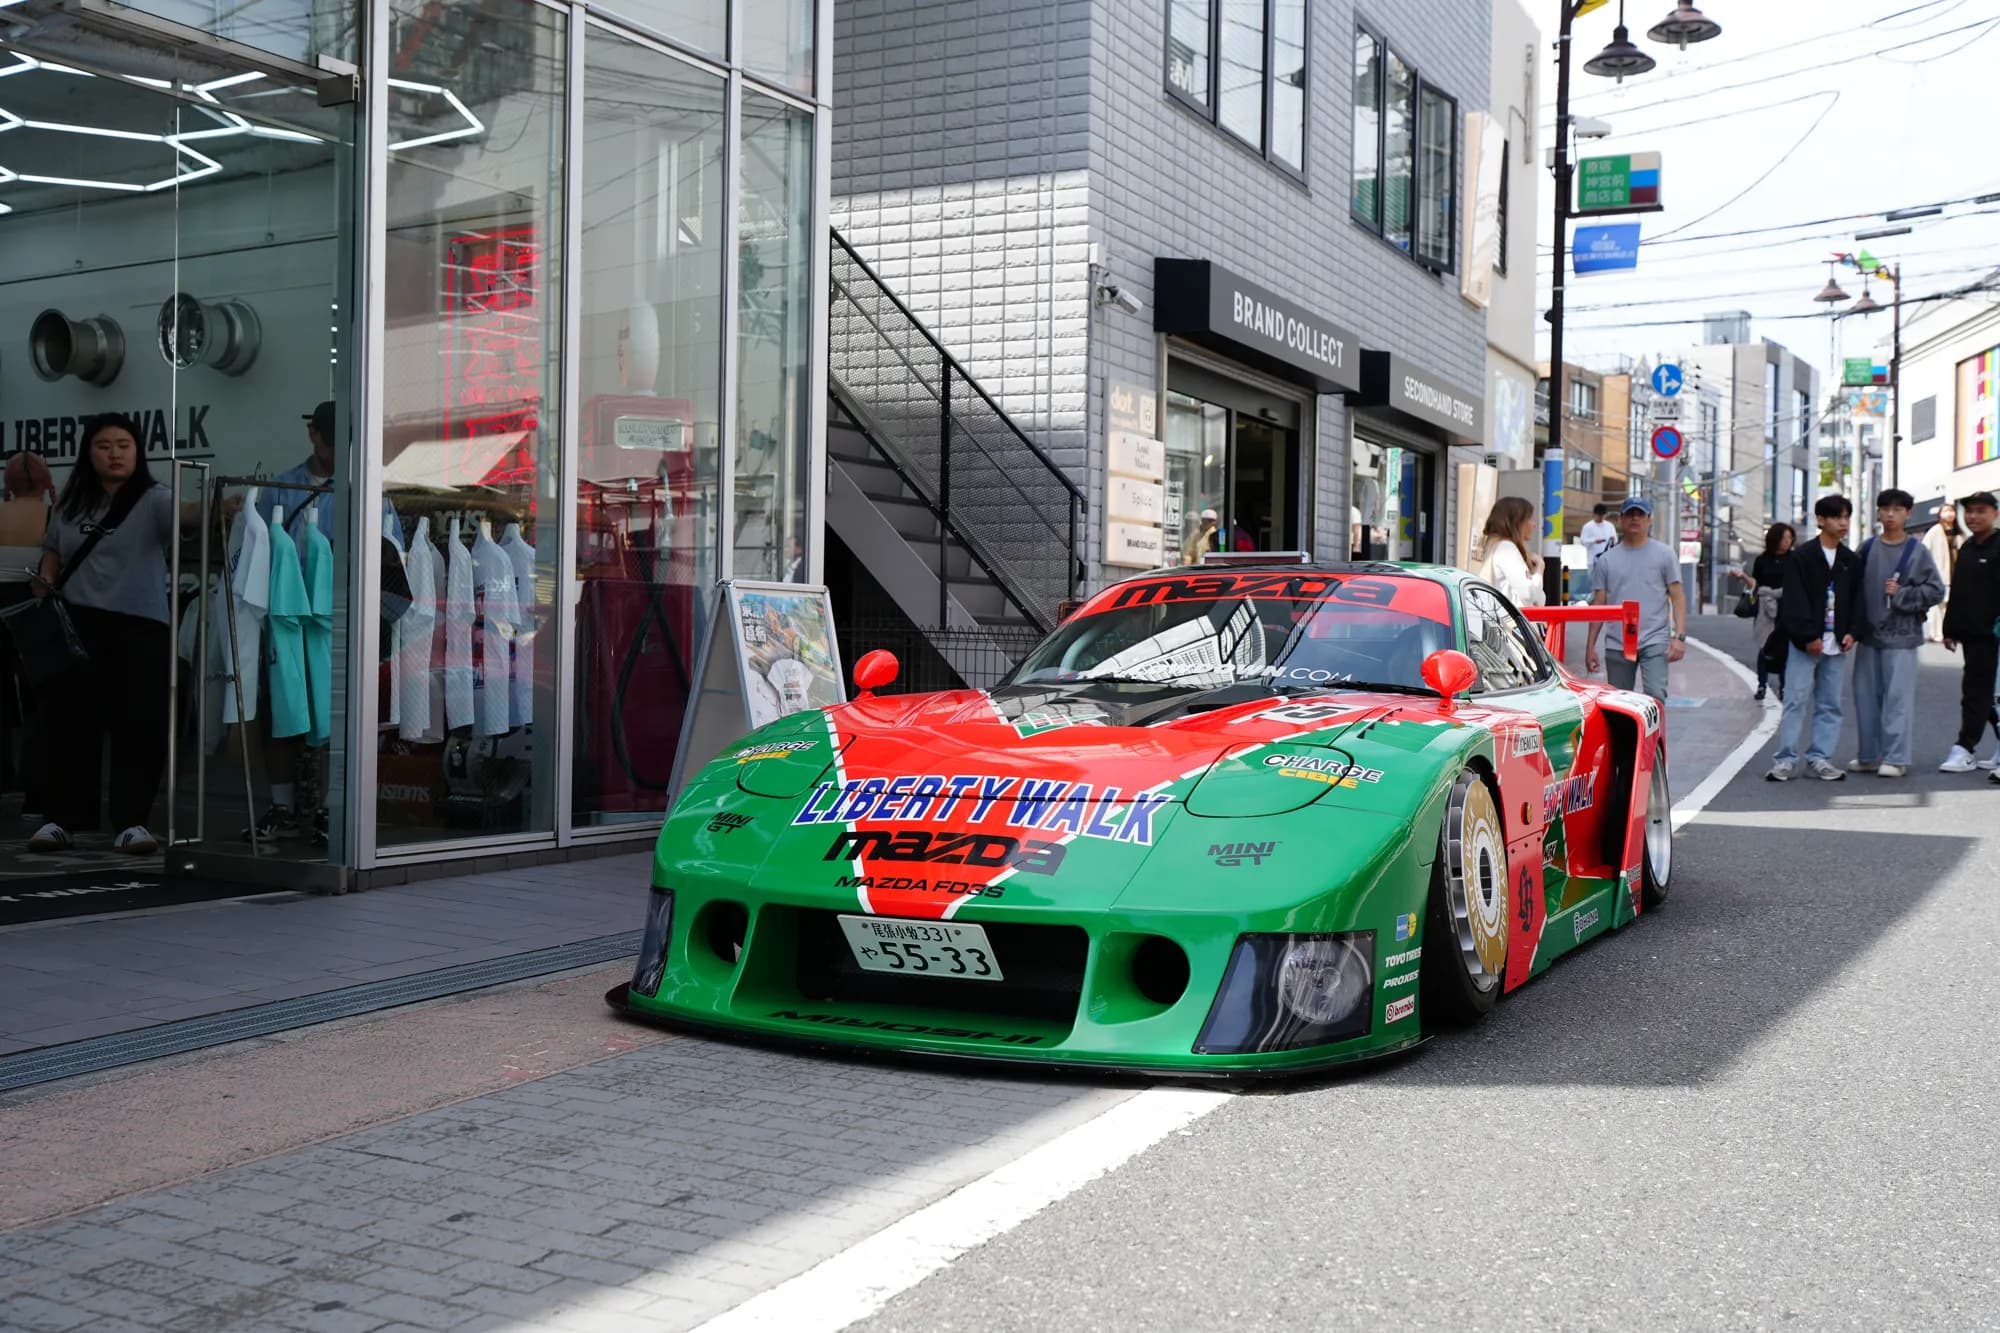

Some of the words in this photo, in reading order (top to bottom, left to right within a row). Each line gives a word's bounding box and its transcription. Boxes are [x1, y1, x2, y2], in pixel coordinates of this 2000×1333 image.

[1233, 290, 1285, 341] BRAND
[1287, 317, 1343, 368] COLLECT
[1404, 375, 1453, 417] SECONDHAND
[1452, 398, 1474, 426] STORE
[733, 740, 820, 758] CHARGE
[1263, 754, 1385, 784] CHARGE
[1567, 770, 1598, 815] WALK
[711, 811, 755, 826] MINI
[791, 775, 1019, 826] LIBERTY
[1006, 778, 1176, 846] WALK
[706, 821, 742, 834] GT
[1208, 841, 1276, 856] MINI
[1215, 853, 1272, 867] GT
[833, 875, 928, 892] MAZDA
[931, 879, 1007, 898] FD3S
[1385, 952, 1407, 968] TOYO
[1406, 946, 1422, 961] TIRES
[1383, 969, 1420, 989] PROXES
[1394, 1000, 1414, 1016] brembo
